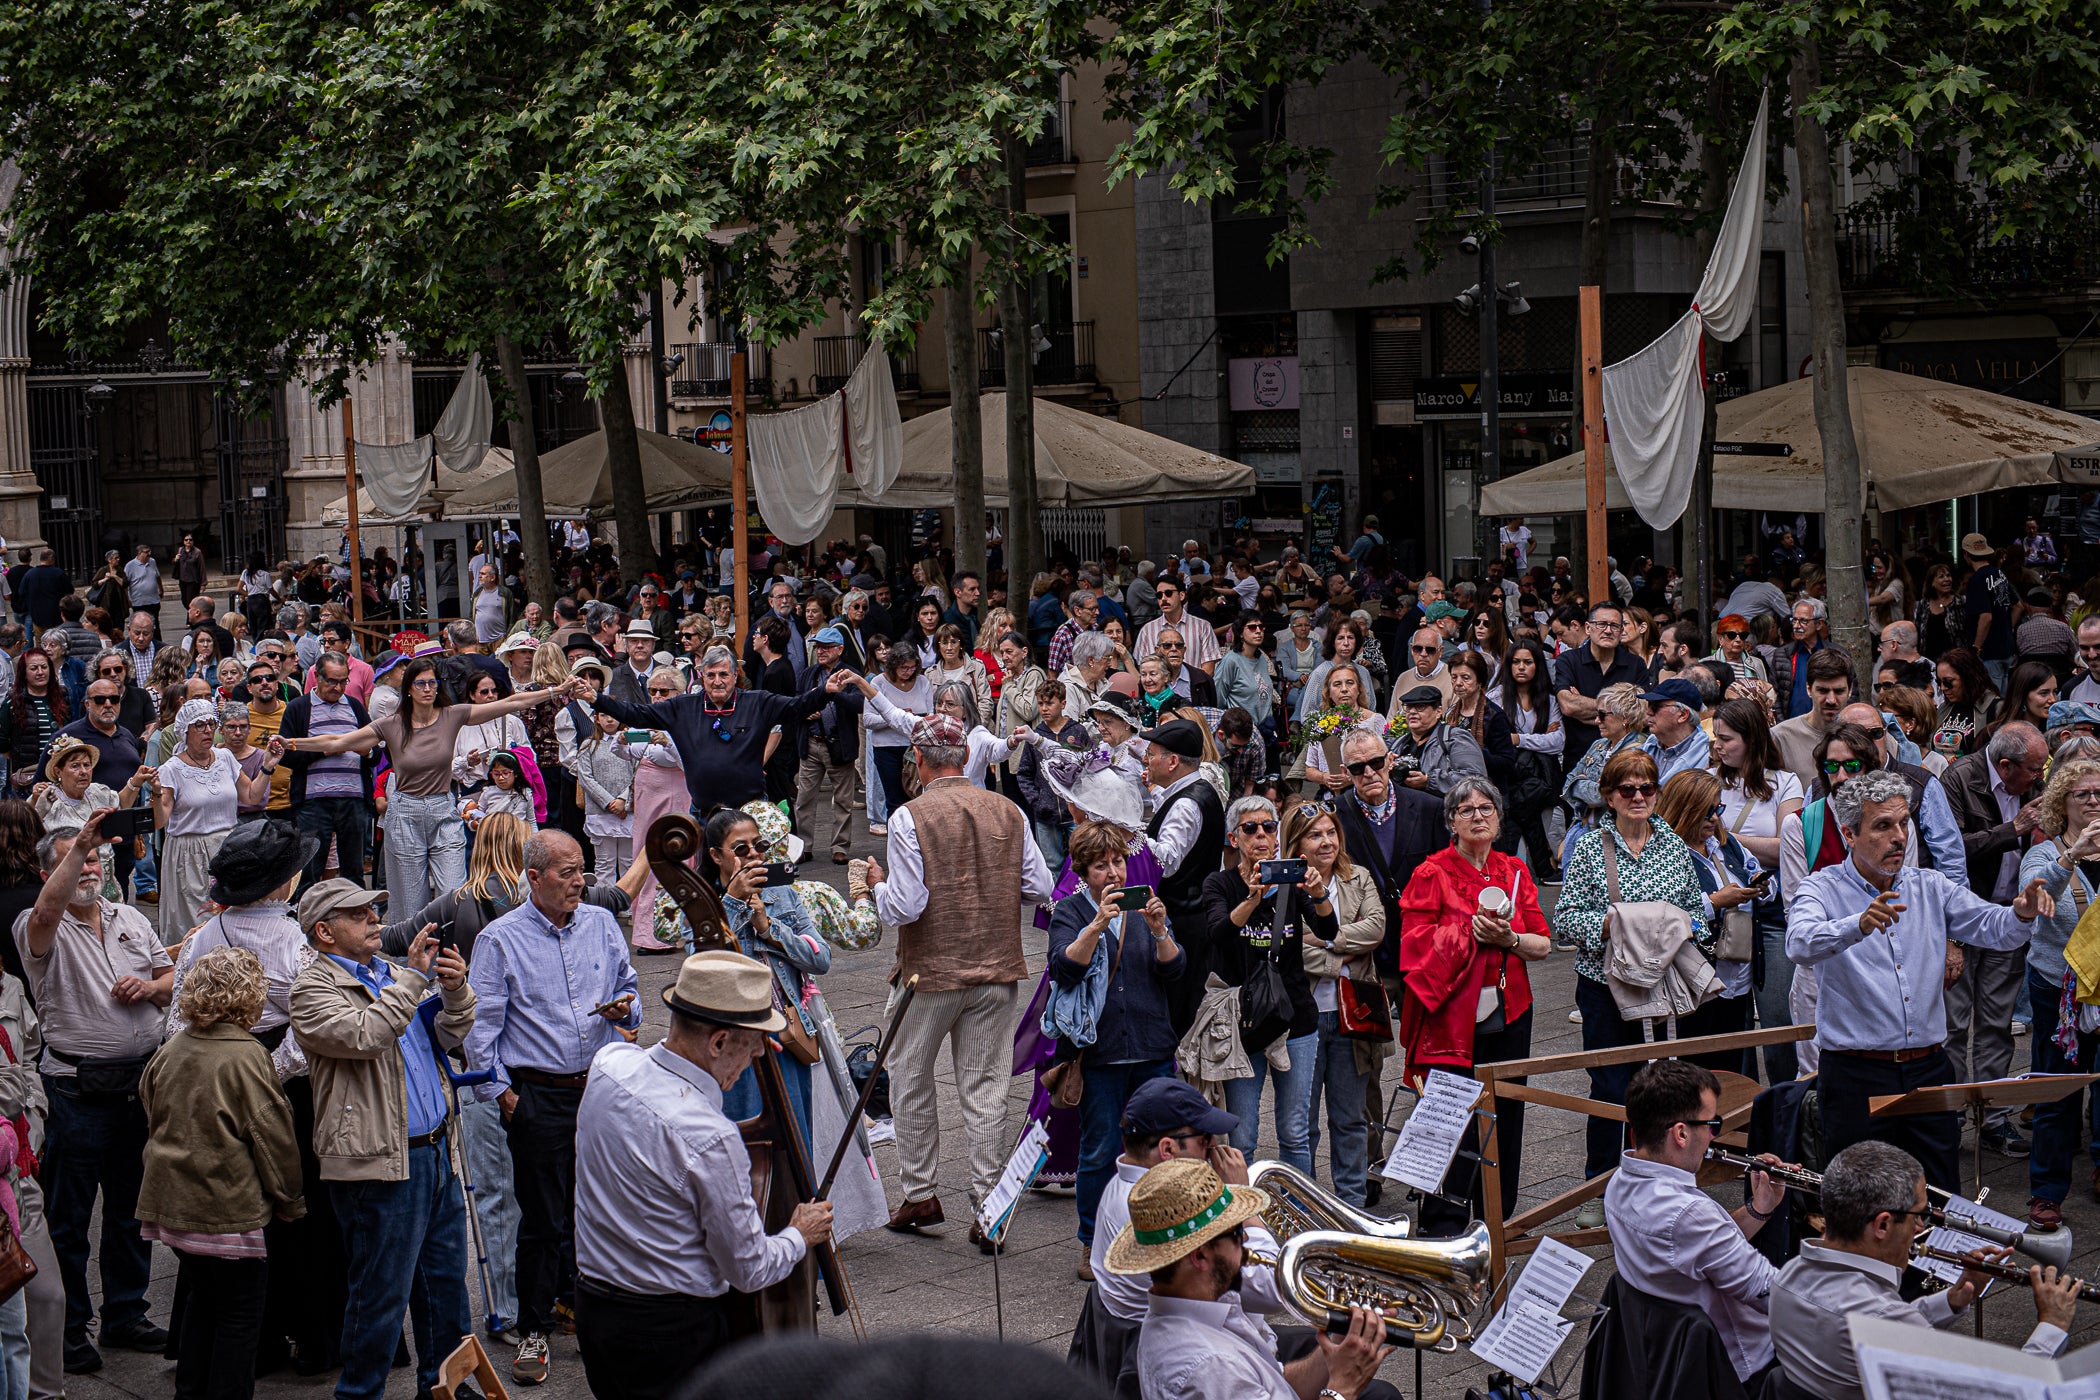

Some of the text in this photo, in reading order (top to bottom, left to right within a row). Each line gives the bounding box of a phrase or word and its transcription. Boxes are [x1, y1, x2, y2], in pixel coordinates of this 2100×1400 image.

[1976, 360, 2041, 380] VELLA
[1416, 391, 1533, 406] Marco Aany
